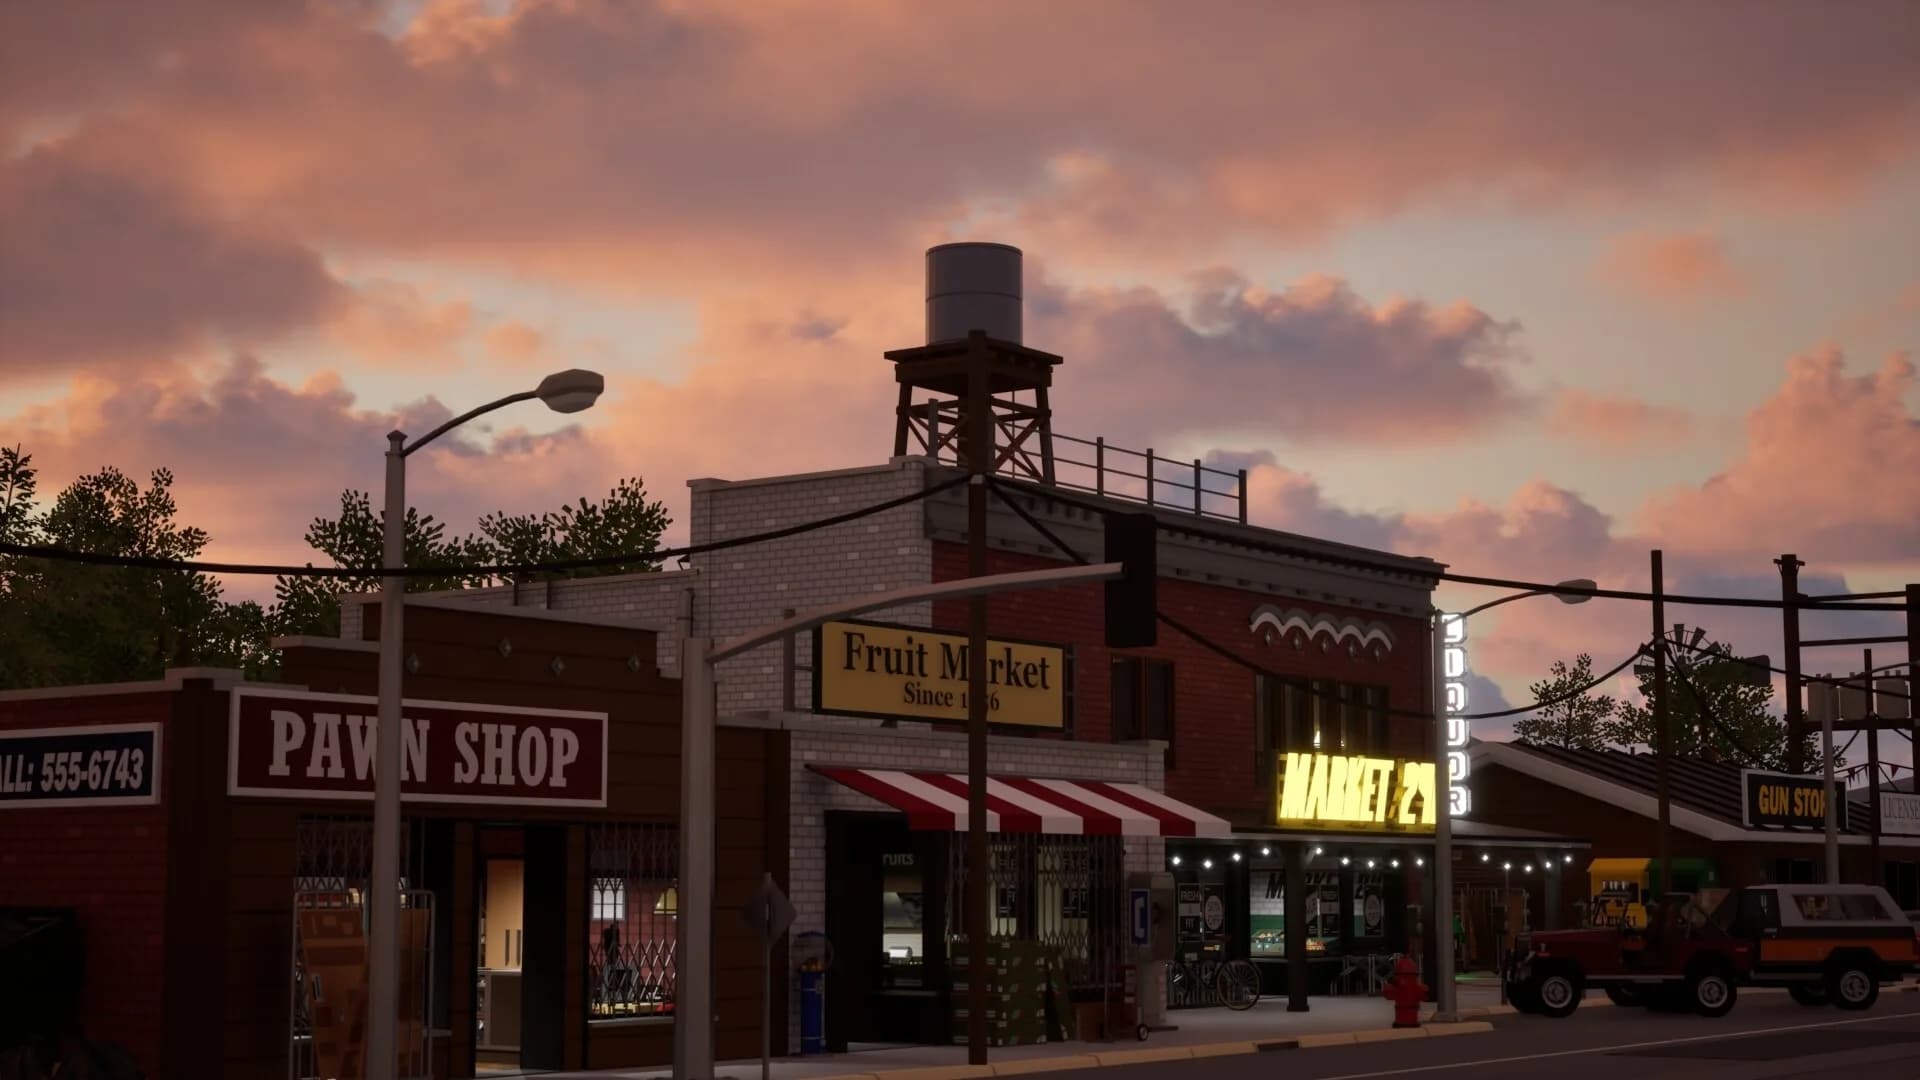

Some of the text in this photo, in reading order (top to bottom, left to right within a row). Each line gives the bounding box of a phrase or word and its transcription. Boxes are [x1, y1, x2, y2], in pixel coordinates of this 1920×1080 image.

[843, 631, 1050, 690] Fruit Mrket
[904, 682, 1000, 711] Since 16
[0, 748, 144, 792] LL: 555-6743
[269, 709, 579, 788] PAWN SHOP
[1280, 752, 1395, 822] MARKET
[1758, 784, 1790, 817] GUN
